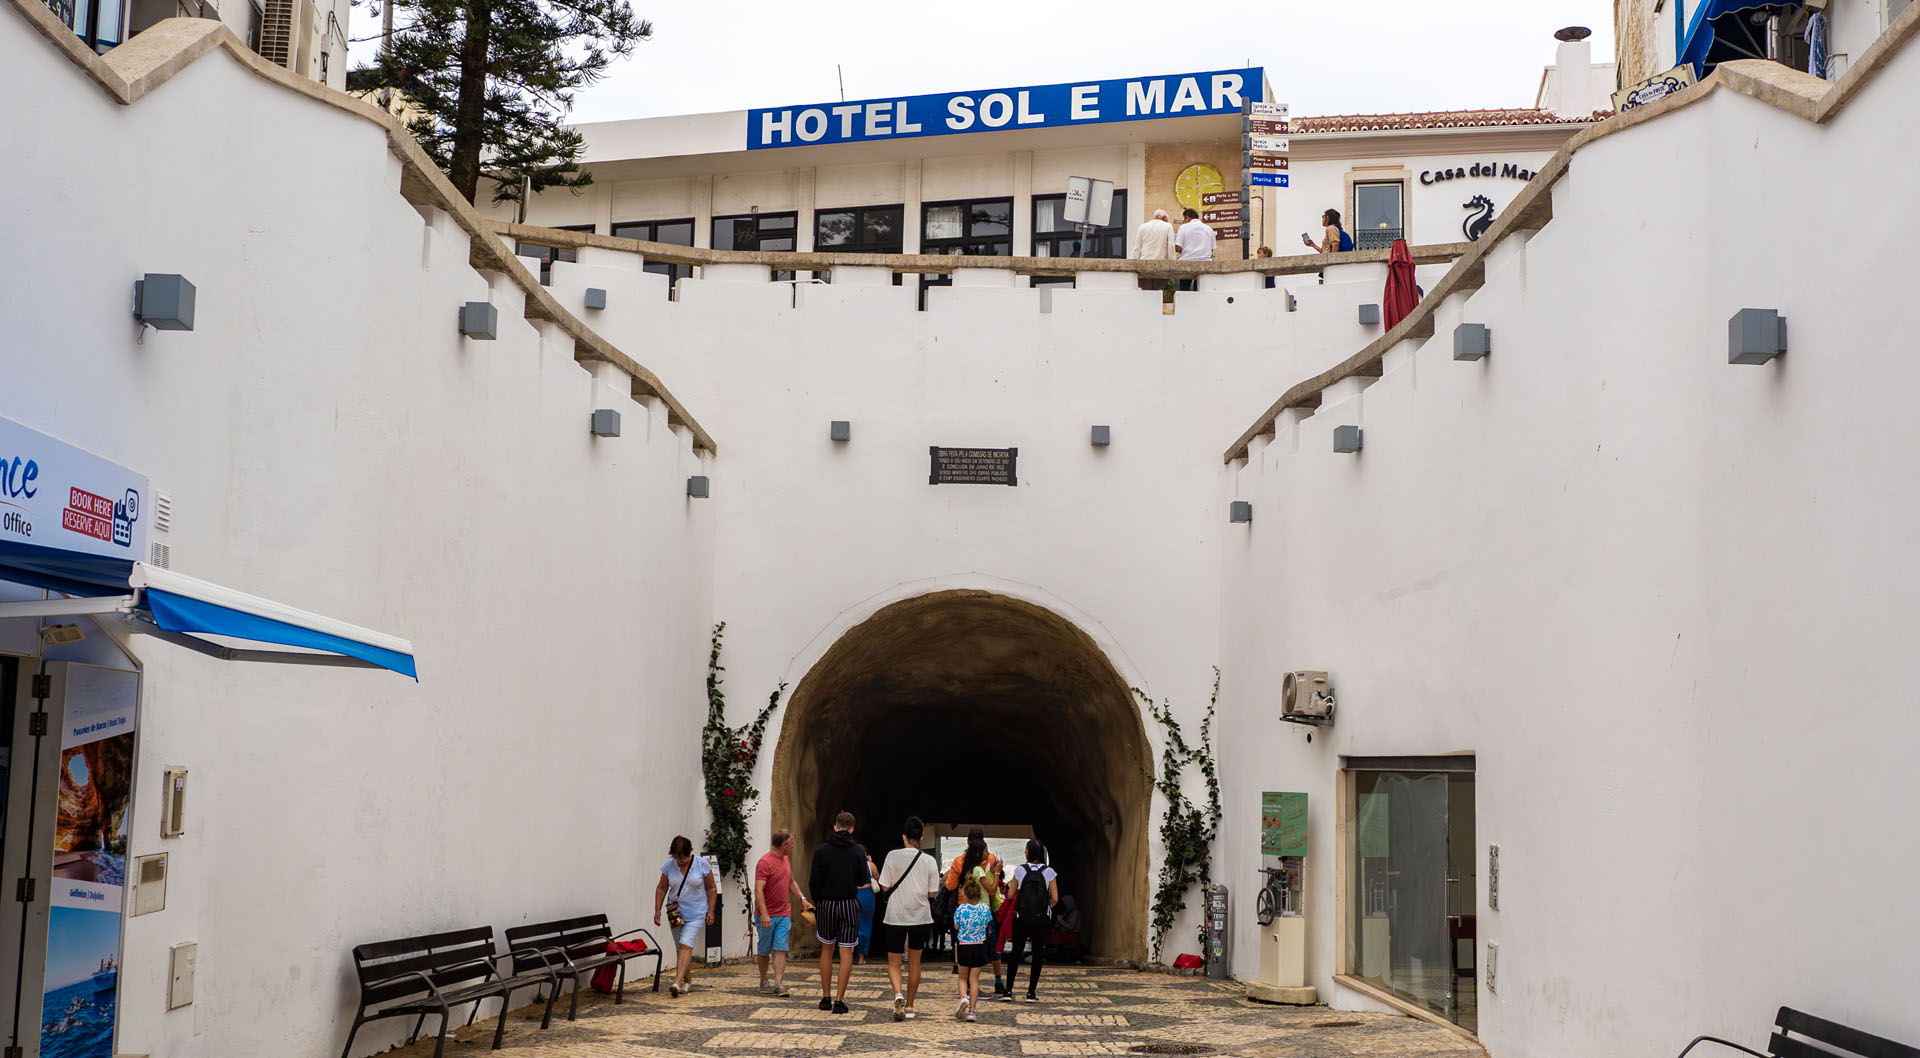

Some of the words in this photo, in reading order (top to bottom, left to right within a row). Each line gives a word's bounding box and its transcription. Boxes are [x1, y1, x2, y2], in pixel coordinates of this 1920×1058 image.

[760, 100, 922, 144] HOTEL
[945, 90, 1044, 131] SOL
[1070, 85, 1100, 120] E
[1126, 73, 1244, 116] MAR
[1420, 167, 1465, 185] Casa
[1469, 162, 1496, 177] del
[71, 490, 92, 514] BOOK
[94, 496, 112, 517] HERE
[4, 512, 32, 537] Office
[64, 510, 92, 534] RESERVE
[94, 520, 111, 540] AQUI
